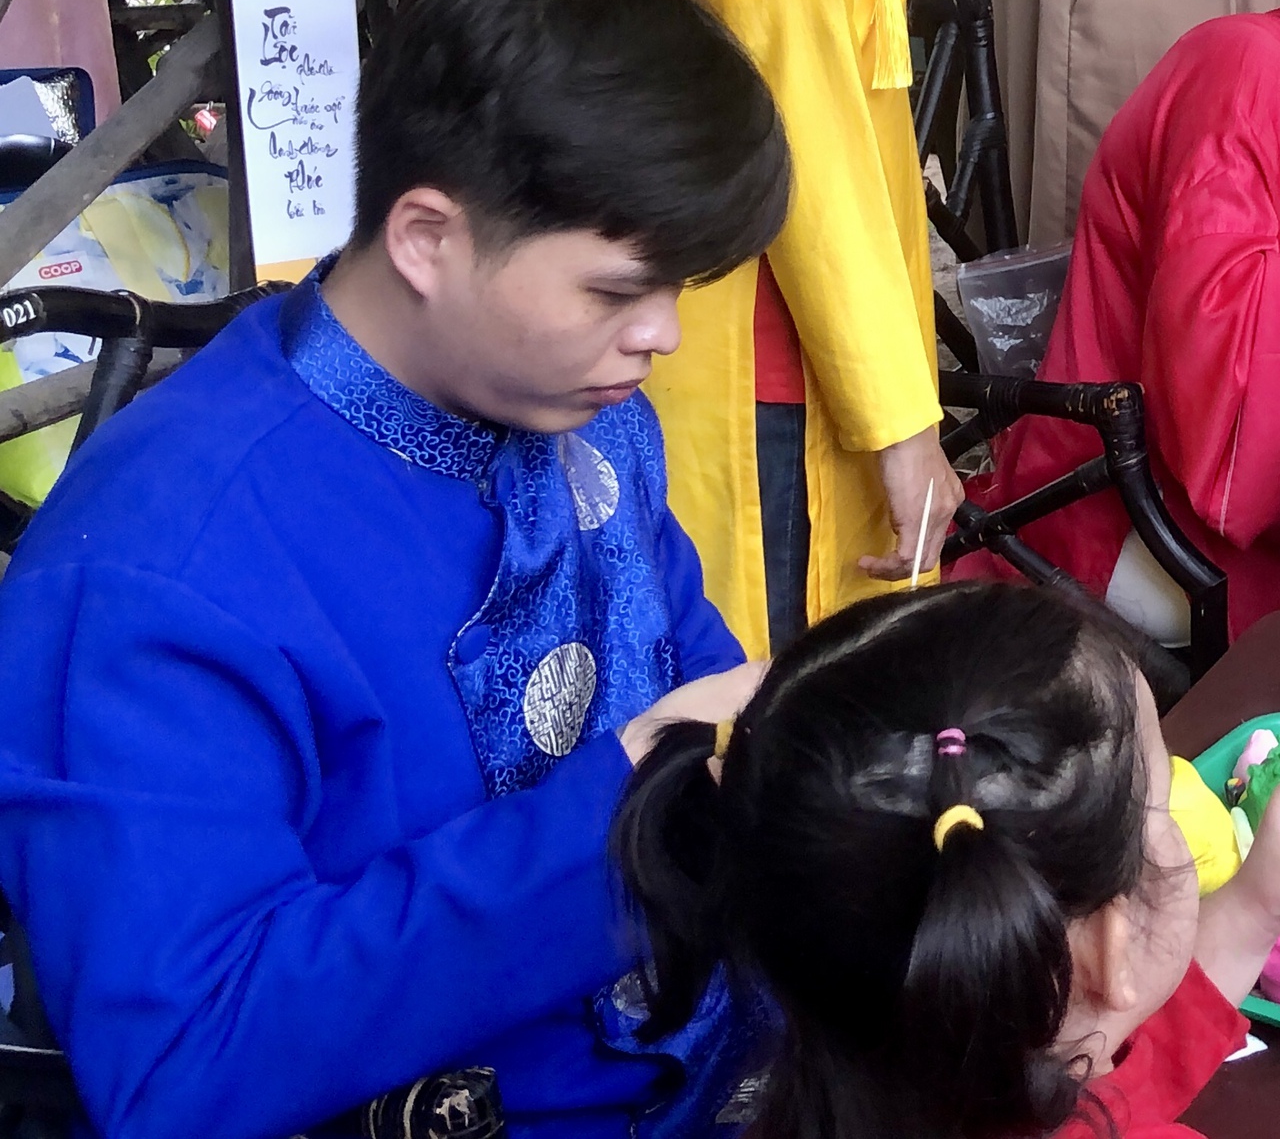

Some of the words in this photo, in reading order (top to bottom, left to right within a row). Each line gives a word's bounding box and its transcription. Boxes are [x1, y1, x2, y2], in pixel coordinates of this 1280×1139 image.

[260, 22, 300, 69] Lộc
[41, 262, 81, 278] COOP
[3, 299, 37, 327] 021
